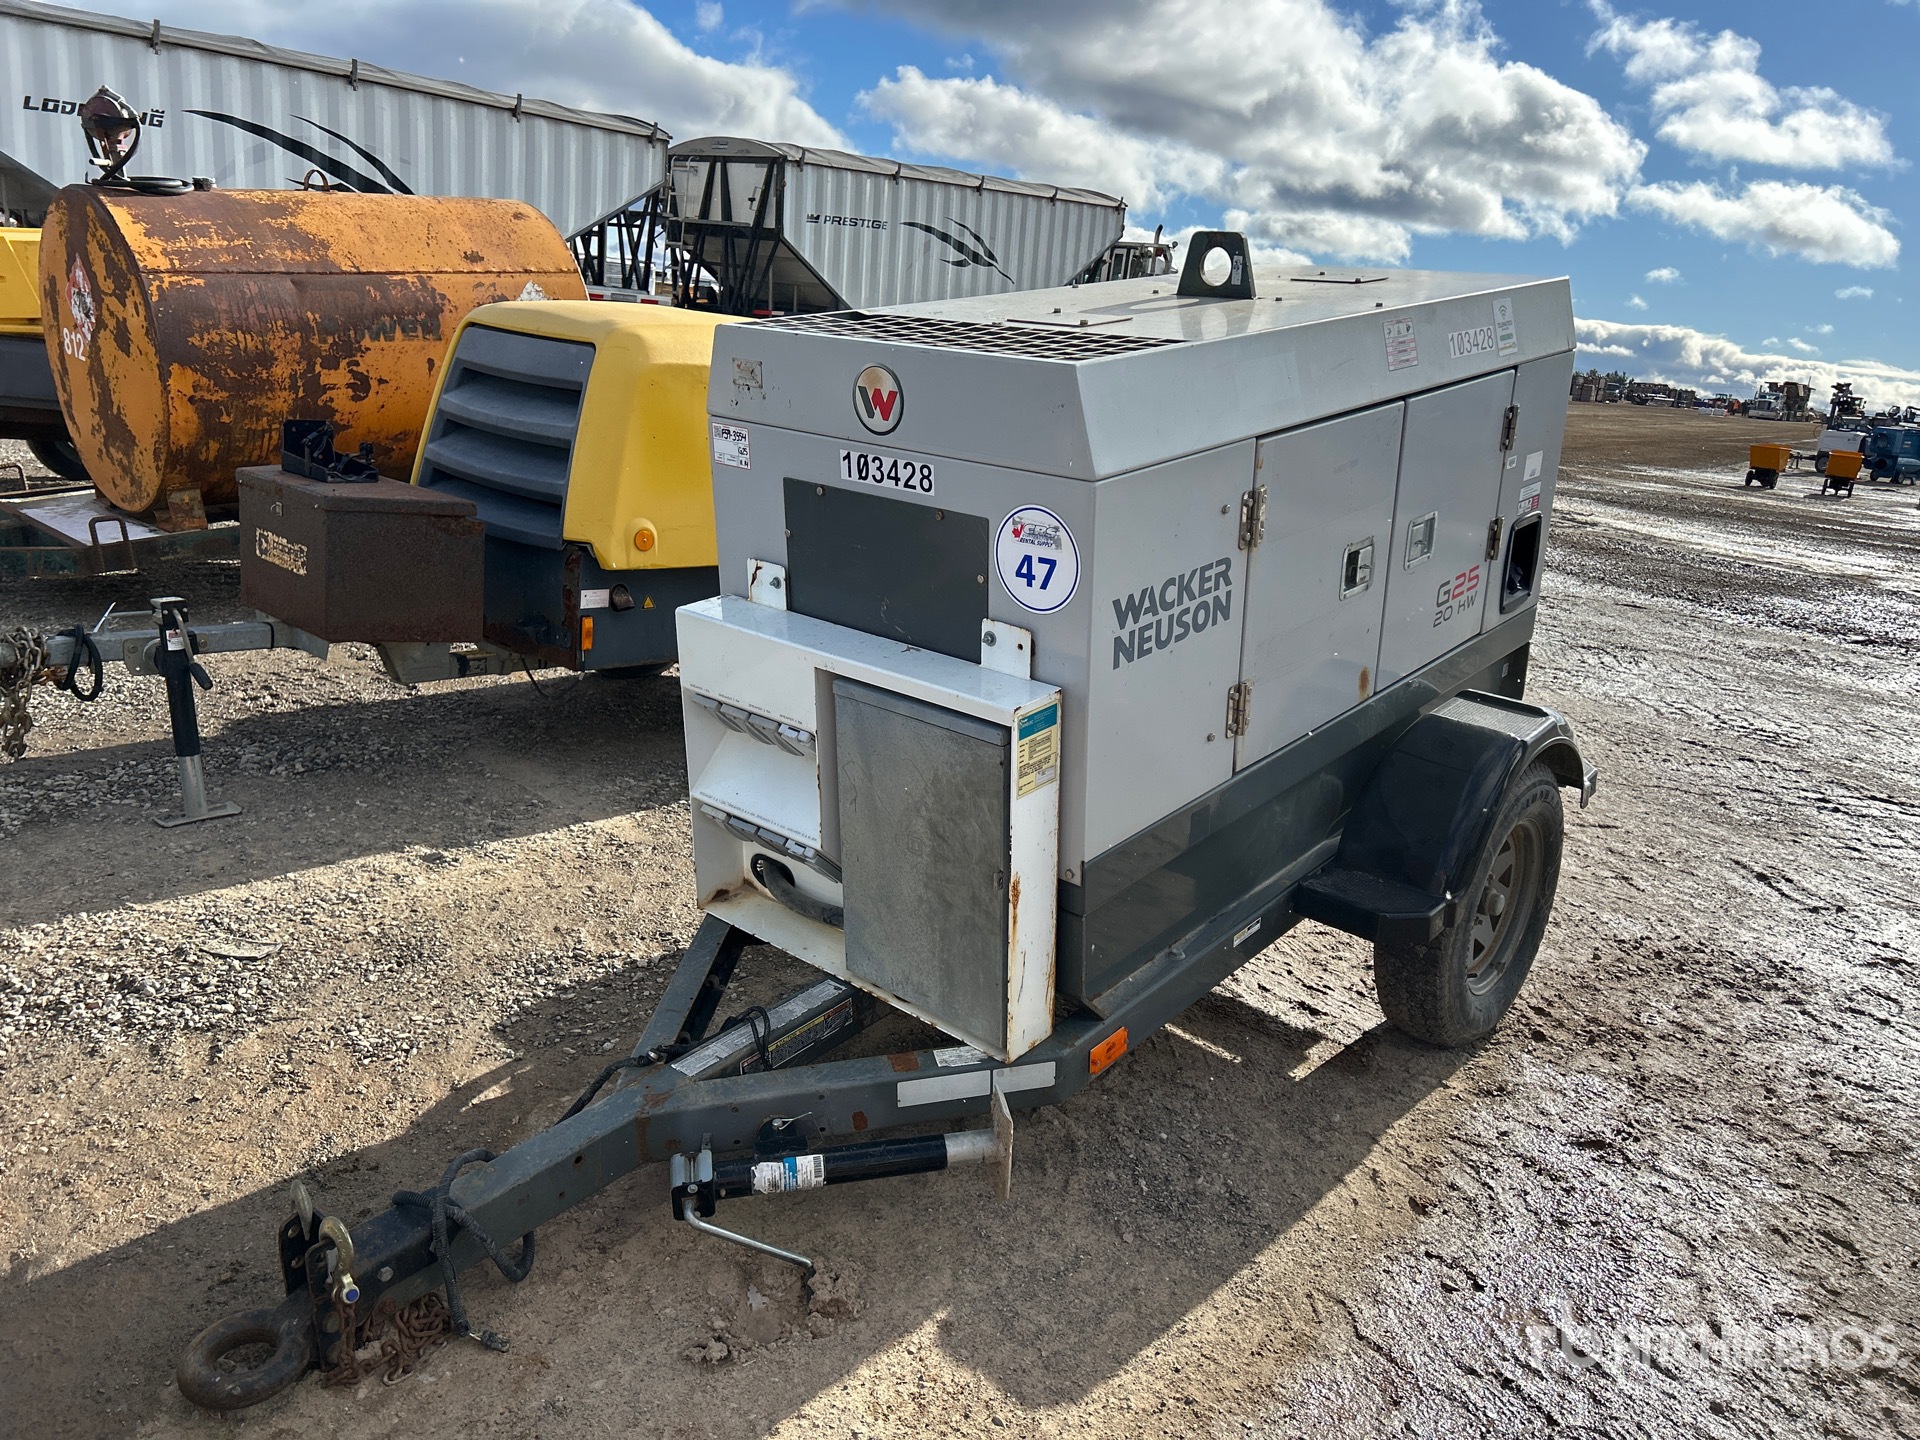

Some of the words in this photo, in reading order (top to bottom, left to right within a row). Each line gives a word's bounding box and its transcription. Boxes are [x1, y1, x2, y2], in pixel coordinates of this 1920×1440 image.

[823, 214, 888, 230] PRESTIGE
[63, 327, 86, 362] 812
[1449, 327, 1494, 356] 103428
[842, 451, 933, 493] 103428
[1019, 537, 1037, 546] RENTAL
[1037, 540, 1054, 548] SUPPLY
[1015, 554, 1057, 590] 47
[1436, 564, 1480, 608] G25
[1112, 557, 1232, 631] WACKER
[1112, 589, 1232, 670] NEUSON
[1433, 605, 1453, 628] 20
